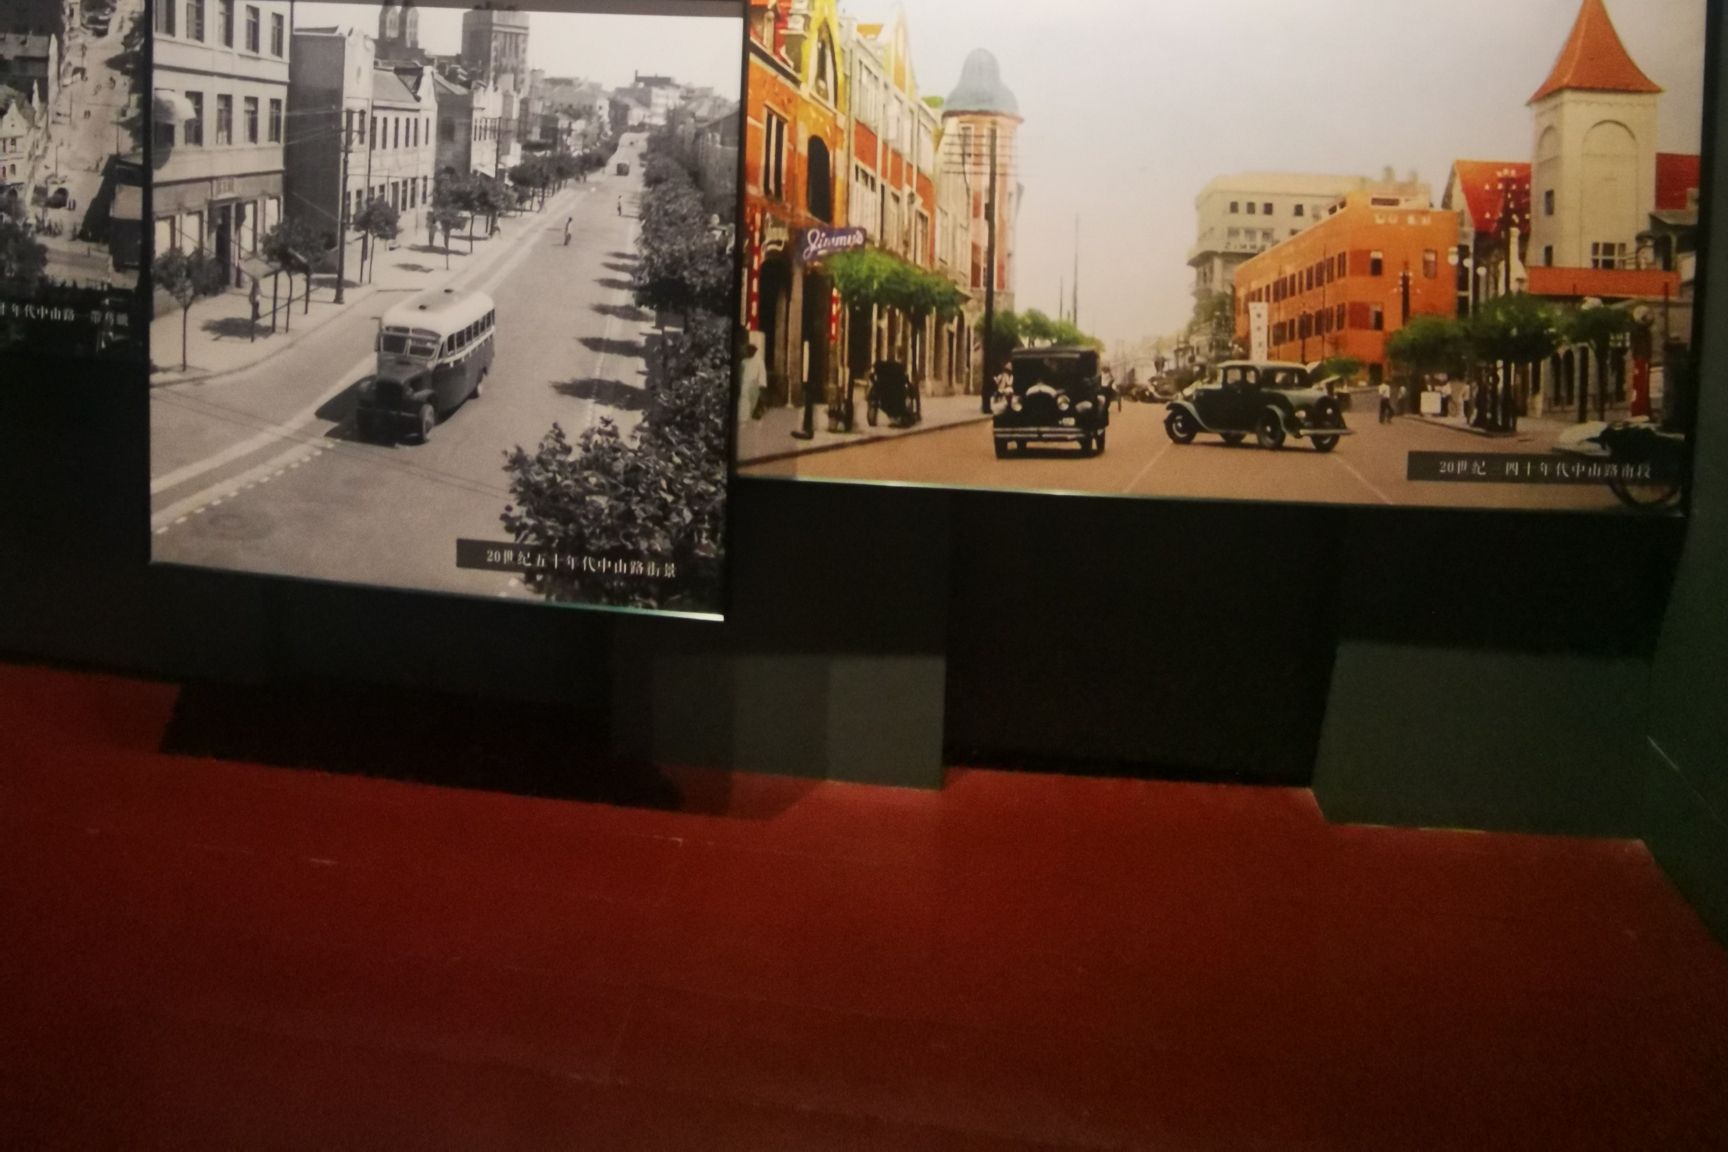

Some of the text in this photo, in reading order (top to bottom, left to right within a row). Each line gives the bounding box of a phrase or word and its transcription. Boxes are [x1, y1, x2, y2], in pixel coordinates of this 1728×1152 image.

[485, 549, 677, 579] 20世纪五十年代中山路街景
